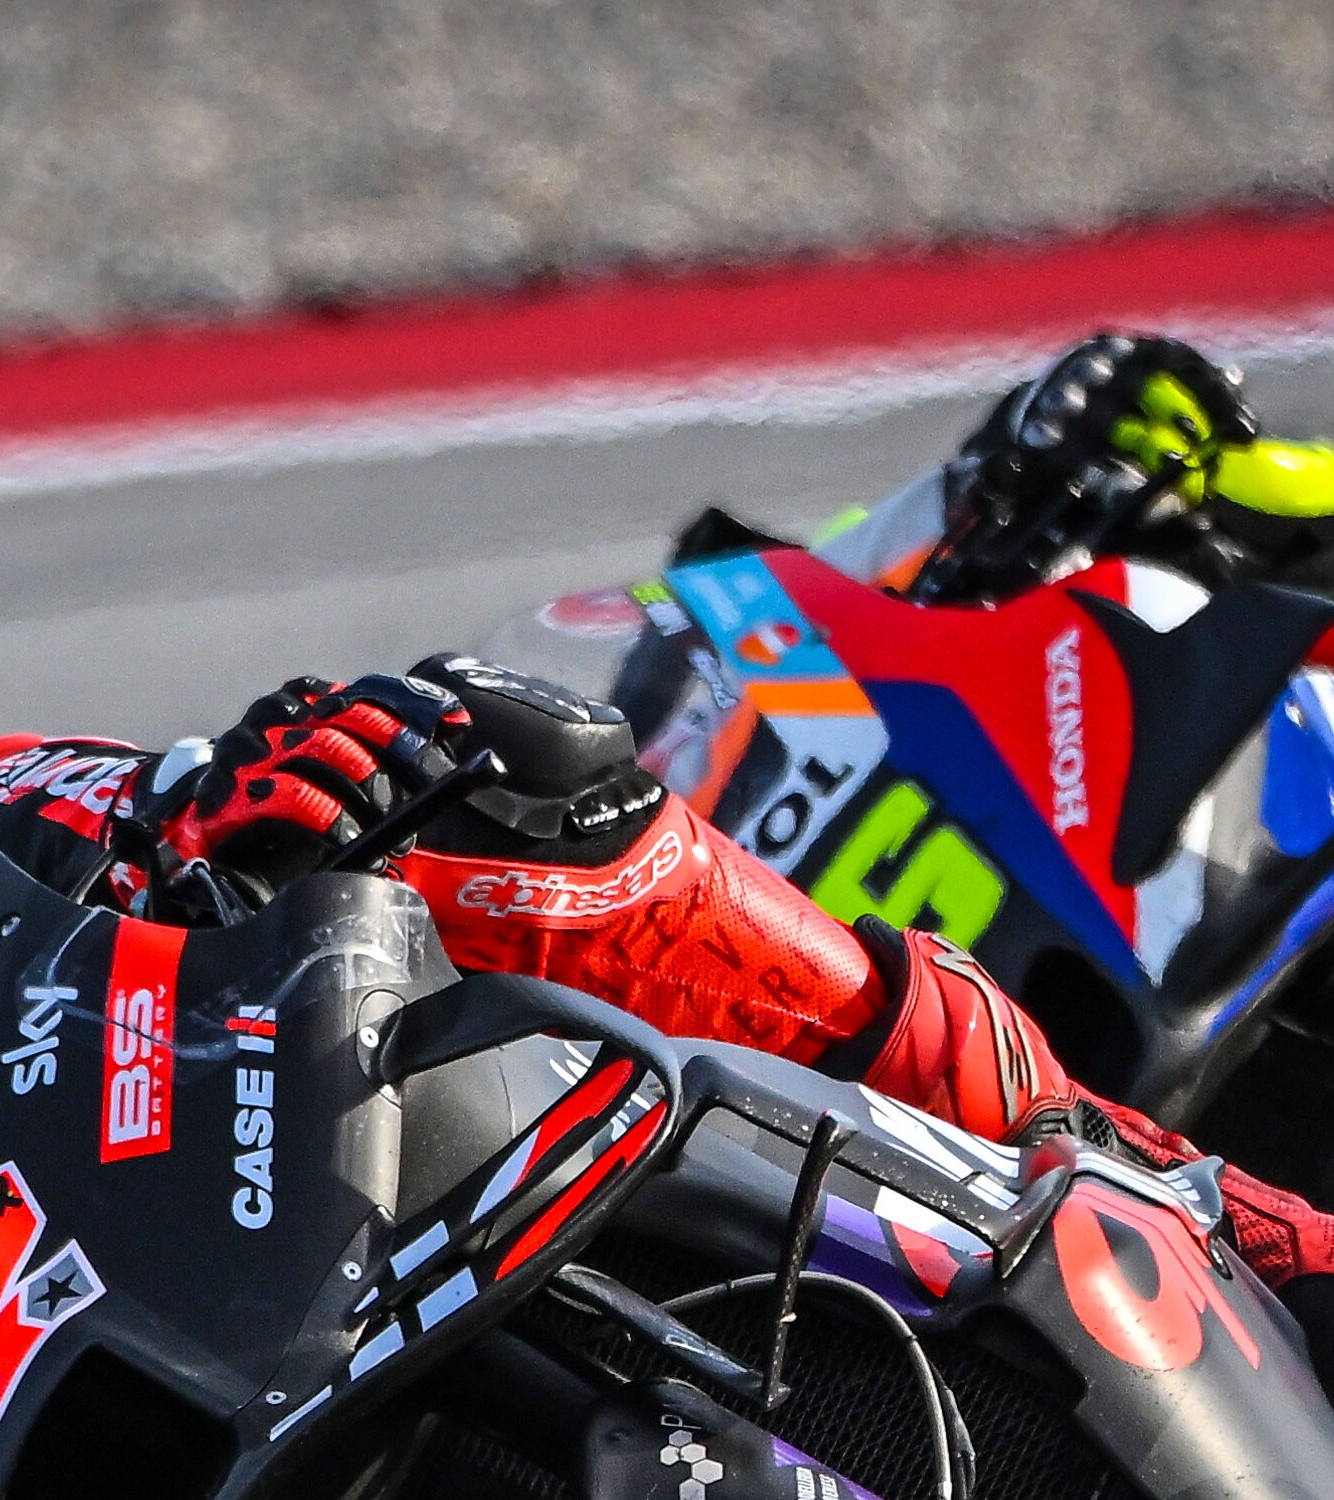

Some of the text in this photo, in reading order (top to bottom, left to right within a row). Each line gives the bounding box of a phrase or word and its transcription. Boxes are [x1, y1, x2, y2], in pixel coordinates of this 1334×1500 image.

[1045, 628, 1089, 837] HONDA
[0, 985, 79, 1096] sky
[108, 988, 154, 1146] BS
[150, 984, 168, 1137] BATTERY
[231, 1067, 276, 1231] CASE
